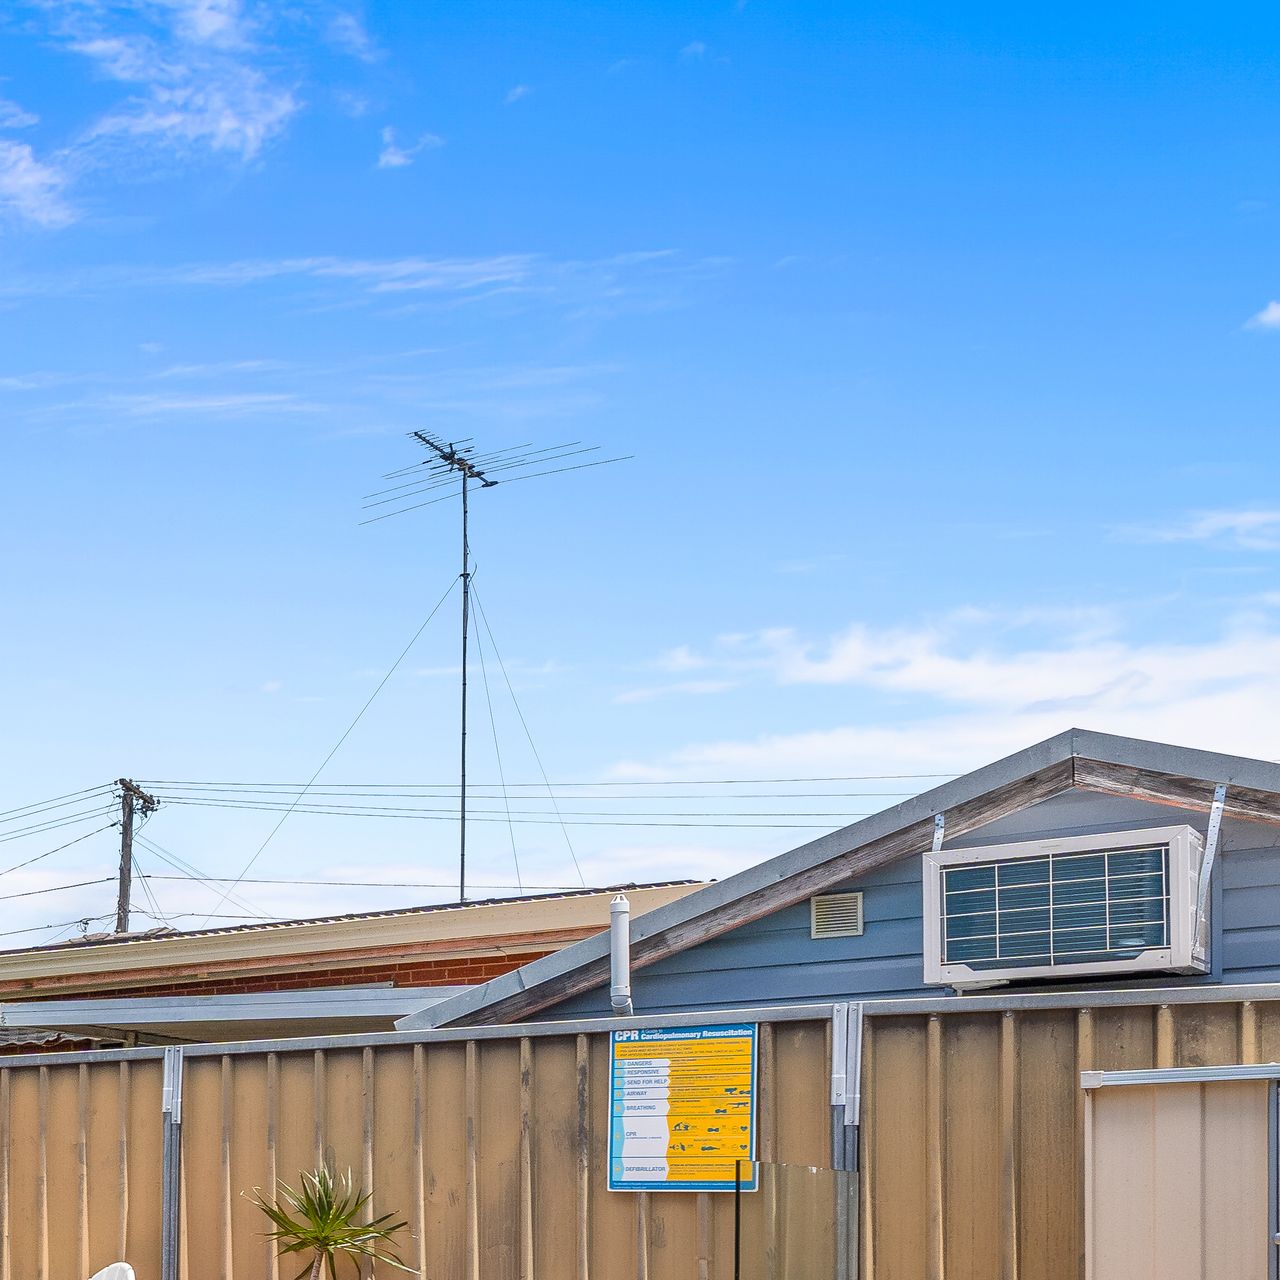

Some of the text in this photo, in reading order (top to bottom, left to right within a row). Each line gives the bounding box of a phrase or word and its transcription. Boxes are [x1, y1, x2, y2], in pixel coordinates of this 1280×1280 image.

[615, 1030, 639, 1041] CPR
[641, 1029, 753, 1041] Cardiopulmonary Resuscitation
